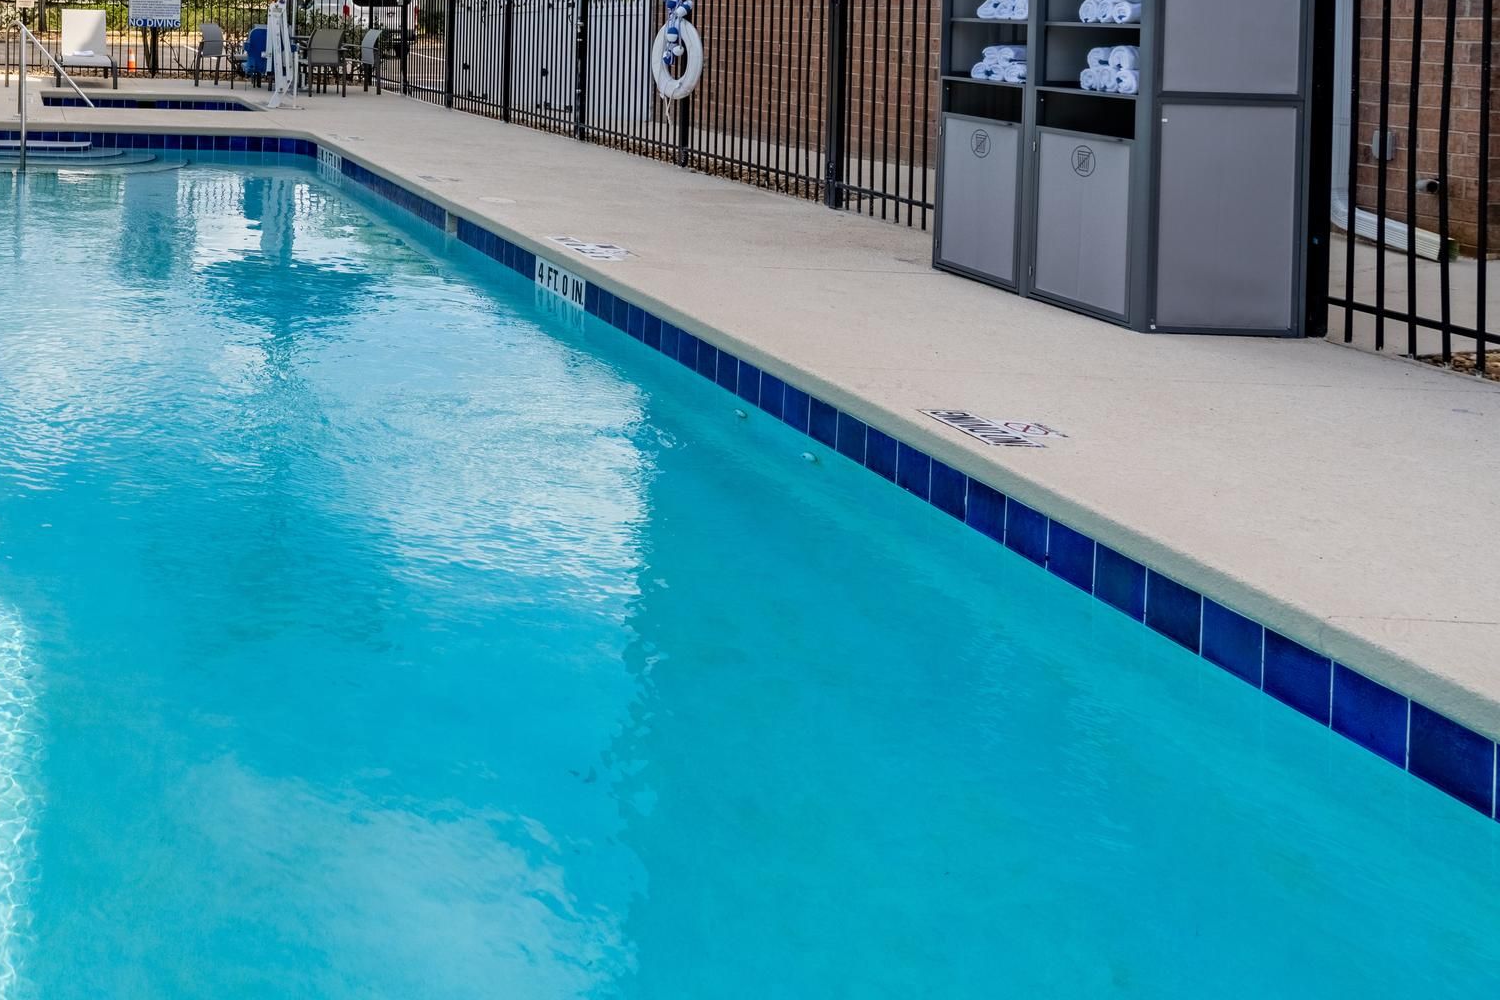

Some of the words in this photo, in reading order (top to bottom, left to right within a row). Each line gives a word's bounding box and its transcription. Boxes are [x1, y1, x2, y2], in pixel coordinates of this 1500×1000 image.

[129, 18, 144, 27] NO
[147, 18, 181, 28] DIVING
[538, 262, 544, 284] 4
